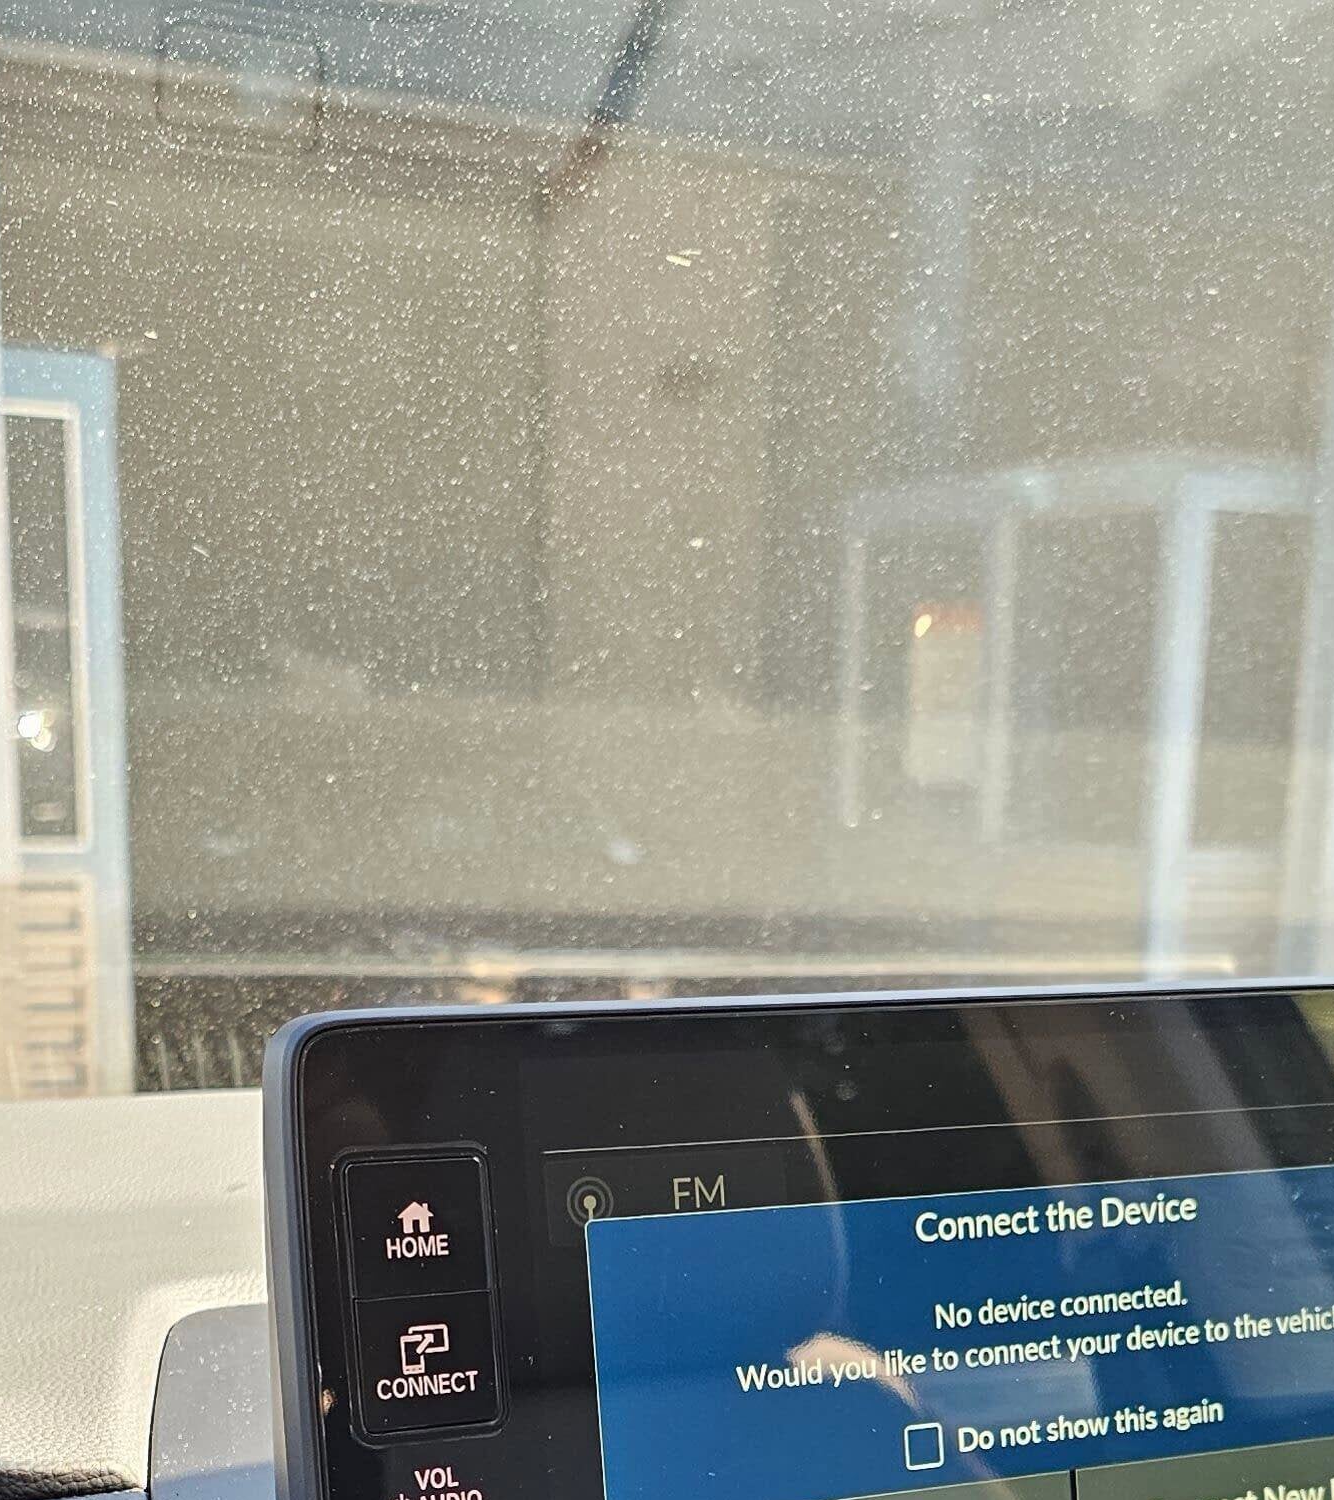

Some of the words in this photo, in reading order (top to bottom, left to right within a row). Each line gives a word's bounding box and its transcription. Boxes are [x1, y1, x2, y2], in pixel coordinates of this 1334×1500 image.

[672, 1174, 726, 1210] FM
[916, 1208, 1039, 1241] Connect
[1046, 1201, 1093, 1231] the
[1102, 1193, 1196, 1227] Device
[386, 1234, 449, 1259] HOME
[936, 1303, 972, 1329] No
[979, 1295, 1055, 1324] device
[1061, 1281, 1187, 1316] connected.
[736, 1359, 823, 1391] Would
[829, 1360, 878, 1387] you
[884, 1350, 926, 1376] like
[932, 1348, 958, 1371] to
[966, 1336, 1061, 1367] connect
[1066, 1334, 1121, 1362] your
[1127, 1322, 1200, 1350] device
[1204, 1320, 1229, 1342] to
[1234, 1314, 1271, 1338] the
[376, 1370, 478, 1400] CONNECT
[959, 1427, 994, 1452] Do
[1001, 1420, 1041, 1447] not
[1047, 1415, 1109, 1441] show
[1114, 1406, 1157, 1433] this
[1163, 1399, 1223, 1430] again
[415, 1467, 459, 1490] VOL
